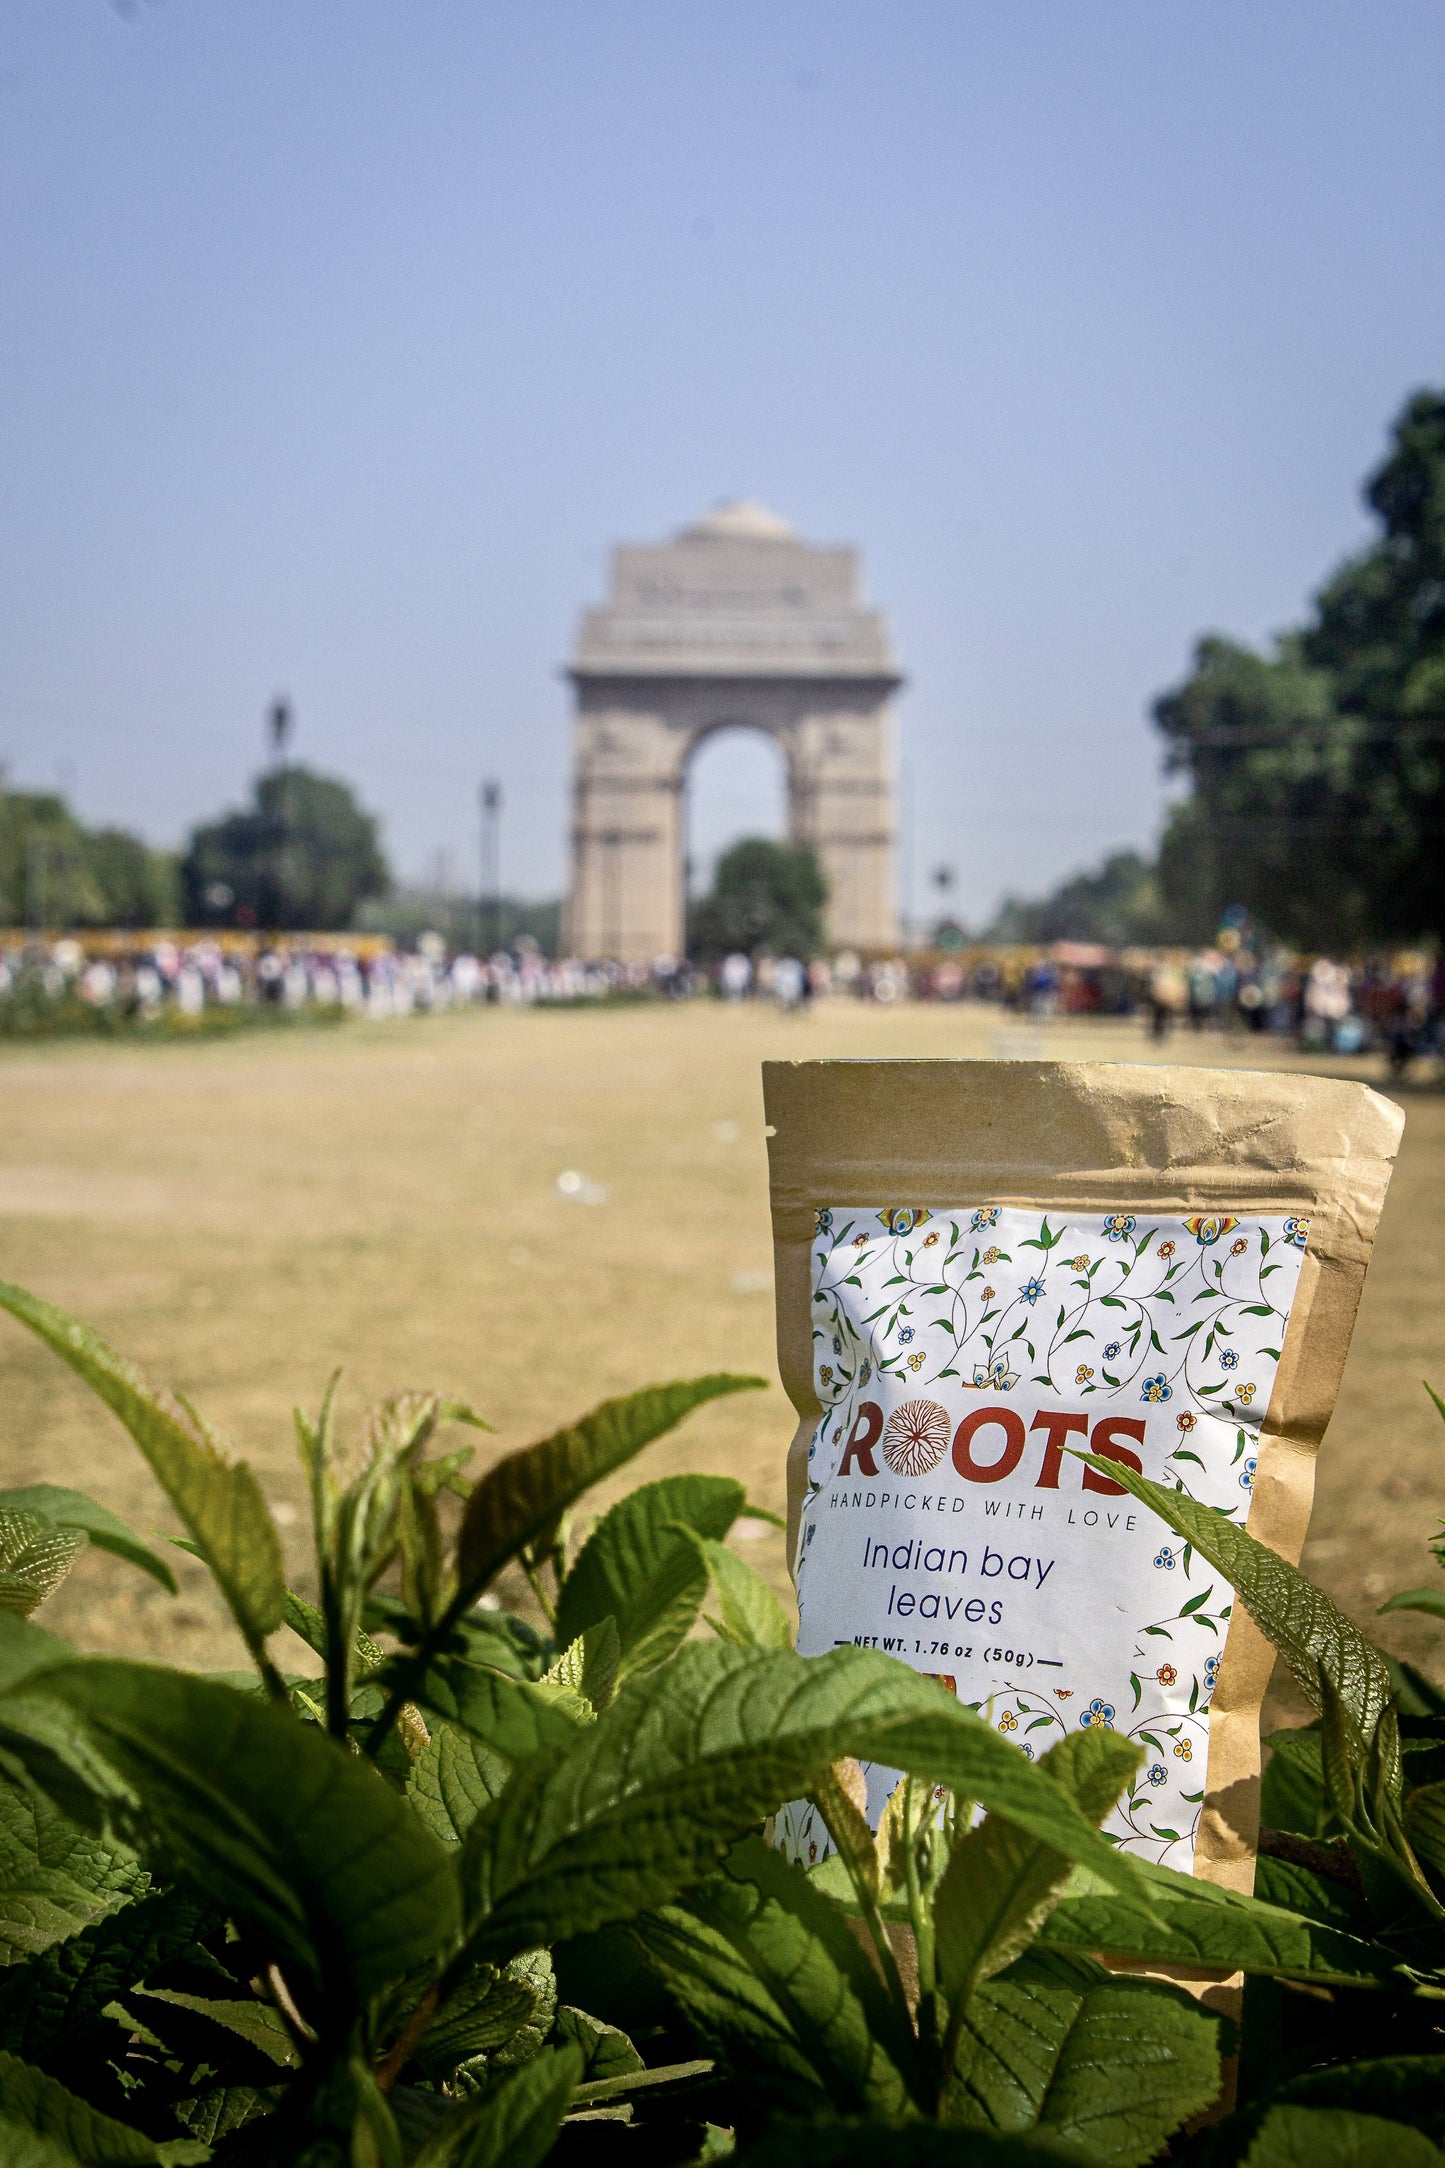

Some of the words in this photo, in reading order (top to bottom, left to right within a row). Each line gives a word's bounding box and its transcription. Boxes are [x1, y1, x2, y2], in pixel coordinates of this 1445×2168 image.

[837, 1399, 1147, 1496] ROOTS
[830, 1493, 965, 1513] HANDPICKED
[984, 1501, 1043, 1521] WITH
[1068, 1509, 1137, 1531] LOVE
[862, 1537, 968, 1574] Indian
[980, 1546, 1055, 1589] bay
[887, 1585, 1003, 1624] leaves
[854, 1635, 878, 1649] NET
[883, 1637, 907, 1652] WT.
[915, 1640, 949, 1655] 1.76
[955, 1646, 972, 1658] oz
[983, 1648, 1034, 1668] (50g)
